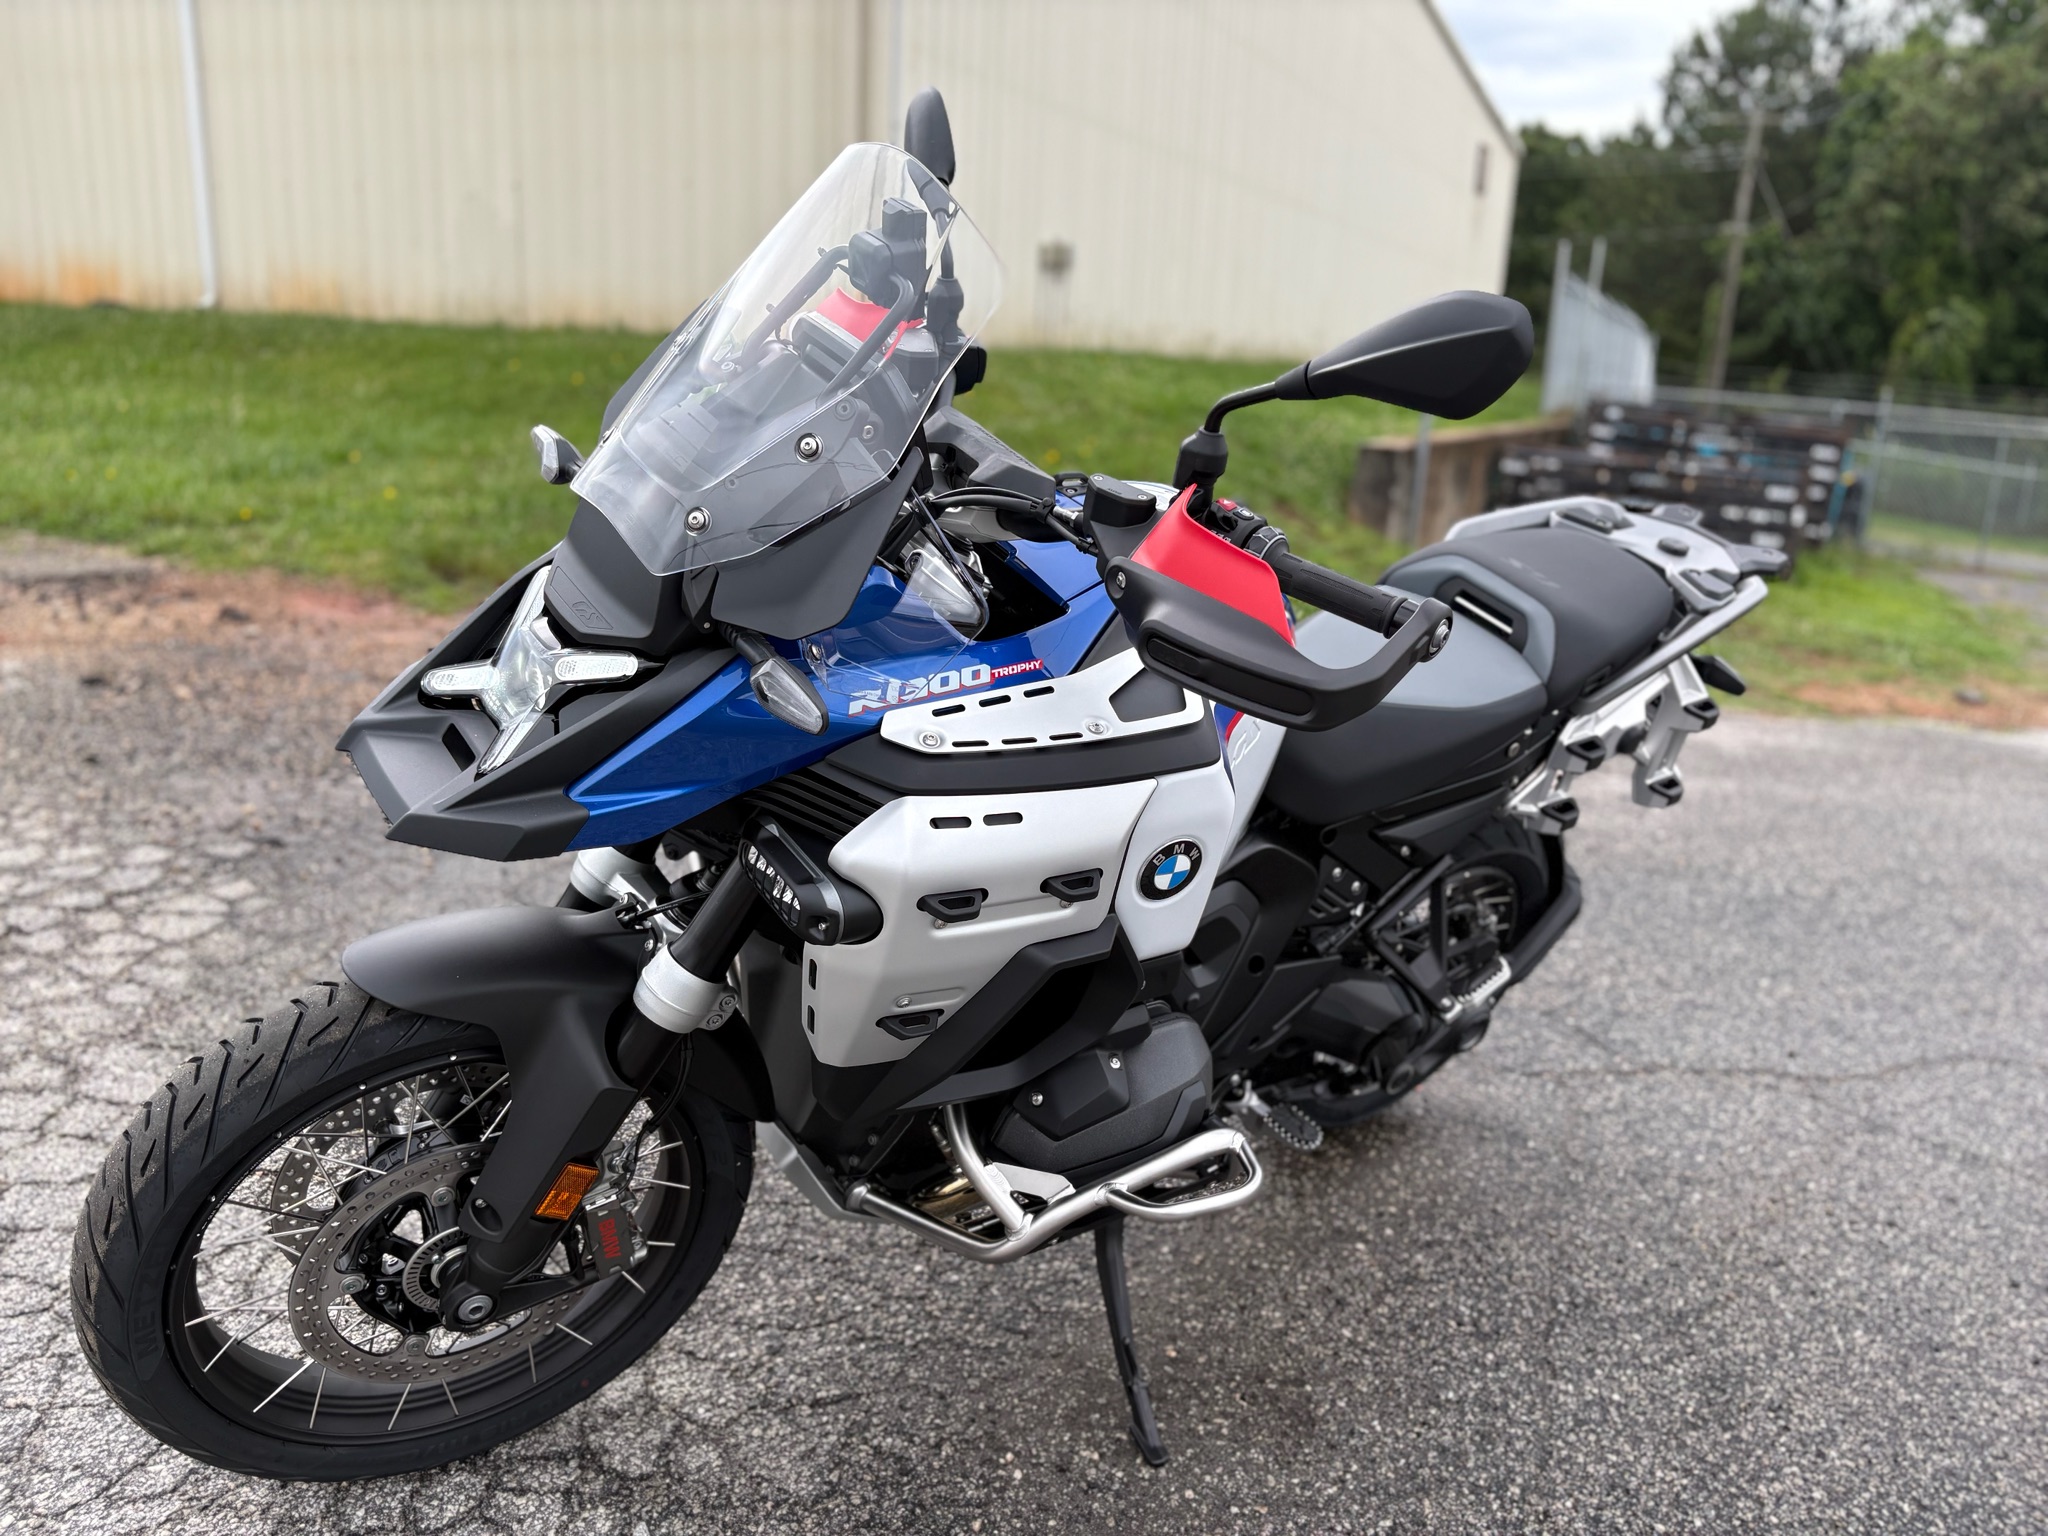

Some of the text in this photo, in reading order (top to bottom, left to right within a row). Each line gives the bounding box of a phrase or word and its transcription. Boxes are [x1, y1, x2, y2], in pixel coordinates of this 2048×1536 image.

[991, 659, 1041, 678] TROPHY
[1152, 843, 1201, 867] BMW
[598, 1218, 621, 1259] BMW
